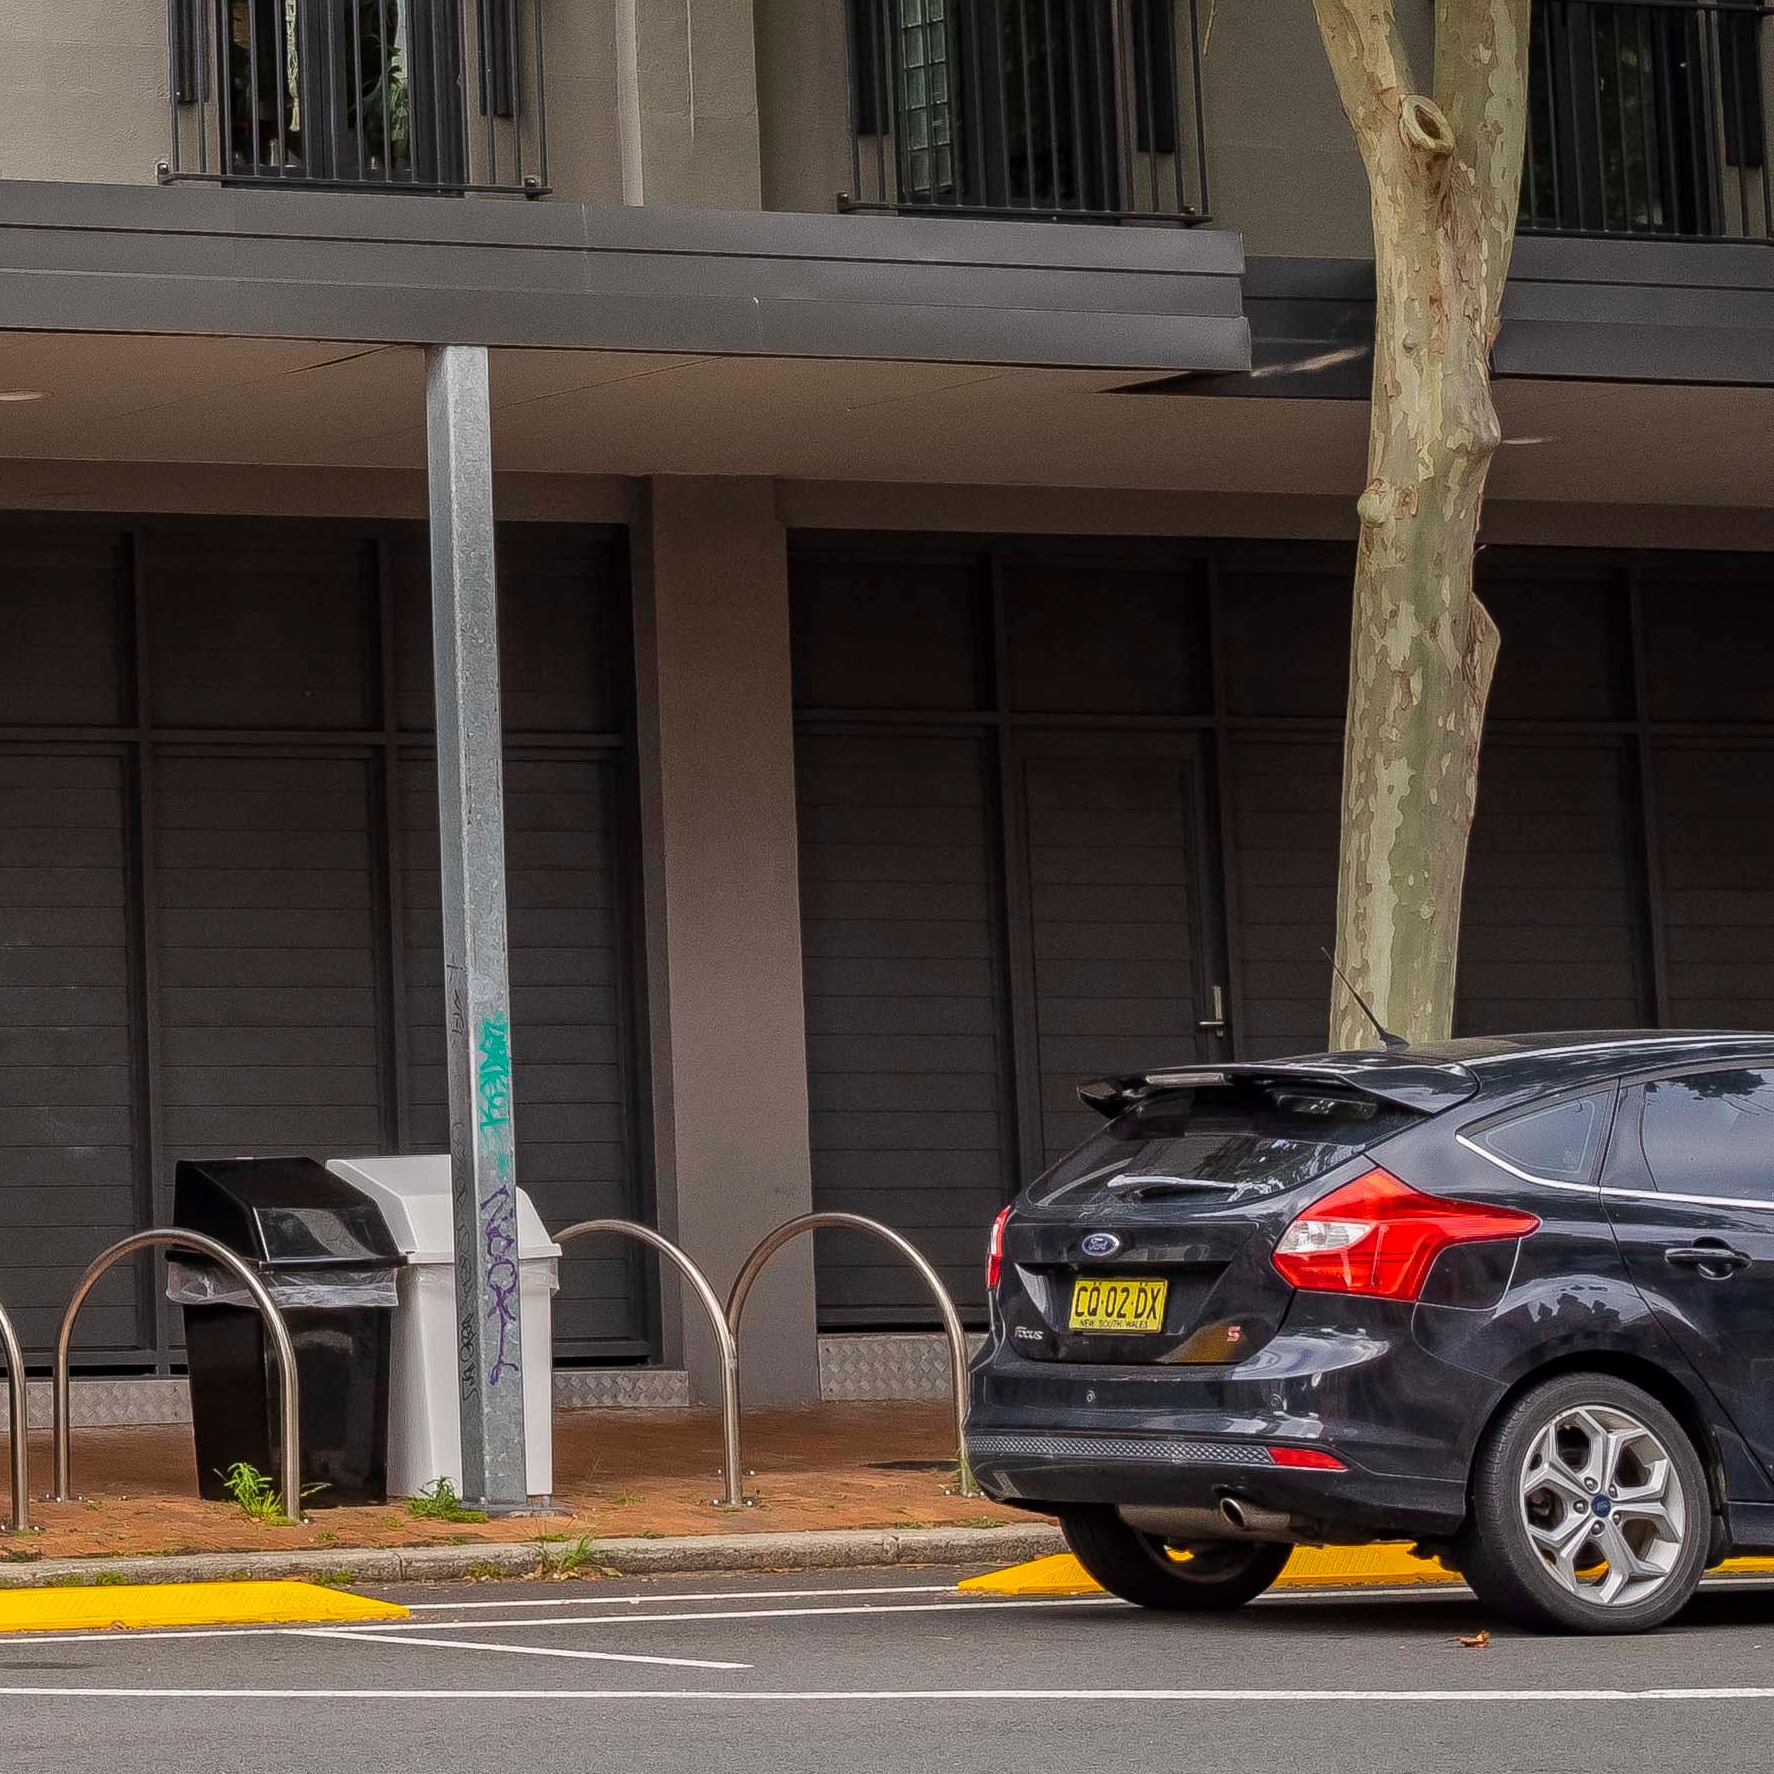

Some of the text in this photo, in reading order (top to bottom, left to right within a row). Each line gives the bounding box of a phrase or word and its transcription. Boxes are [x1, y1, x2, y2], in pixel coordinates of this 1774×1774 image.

[1079, 1319, 1149, 1329] NEW SOUTH WALES
[1227, 1325, 1241, 1343] S
